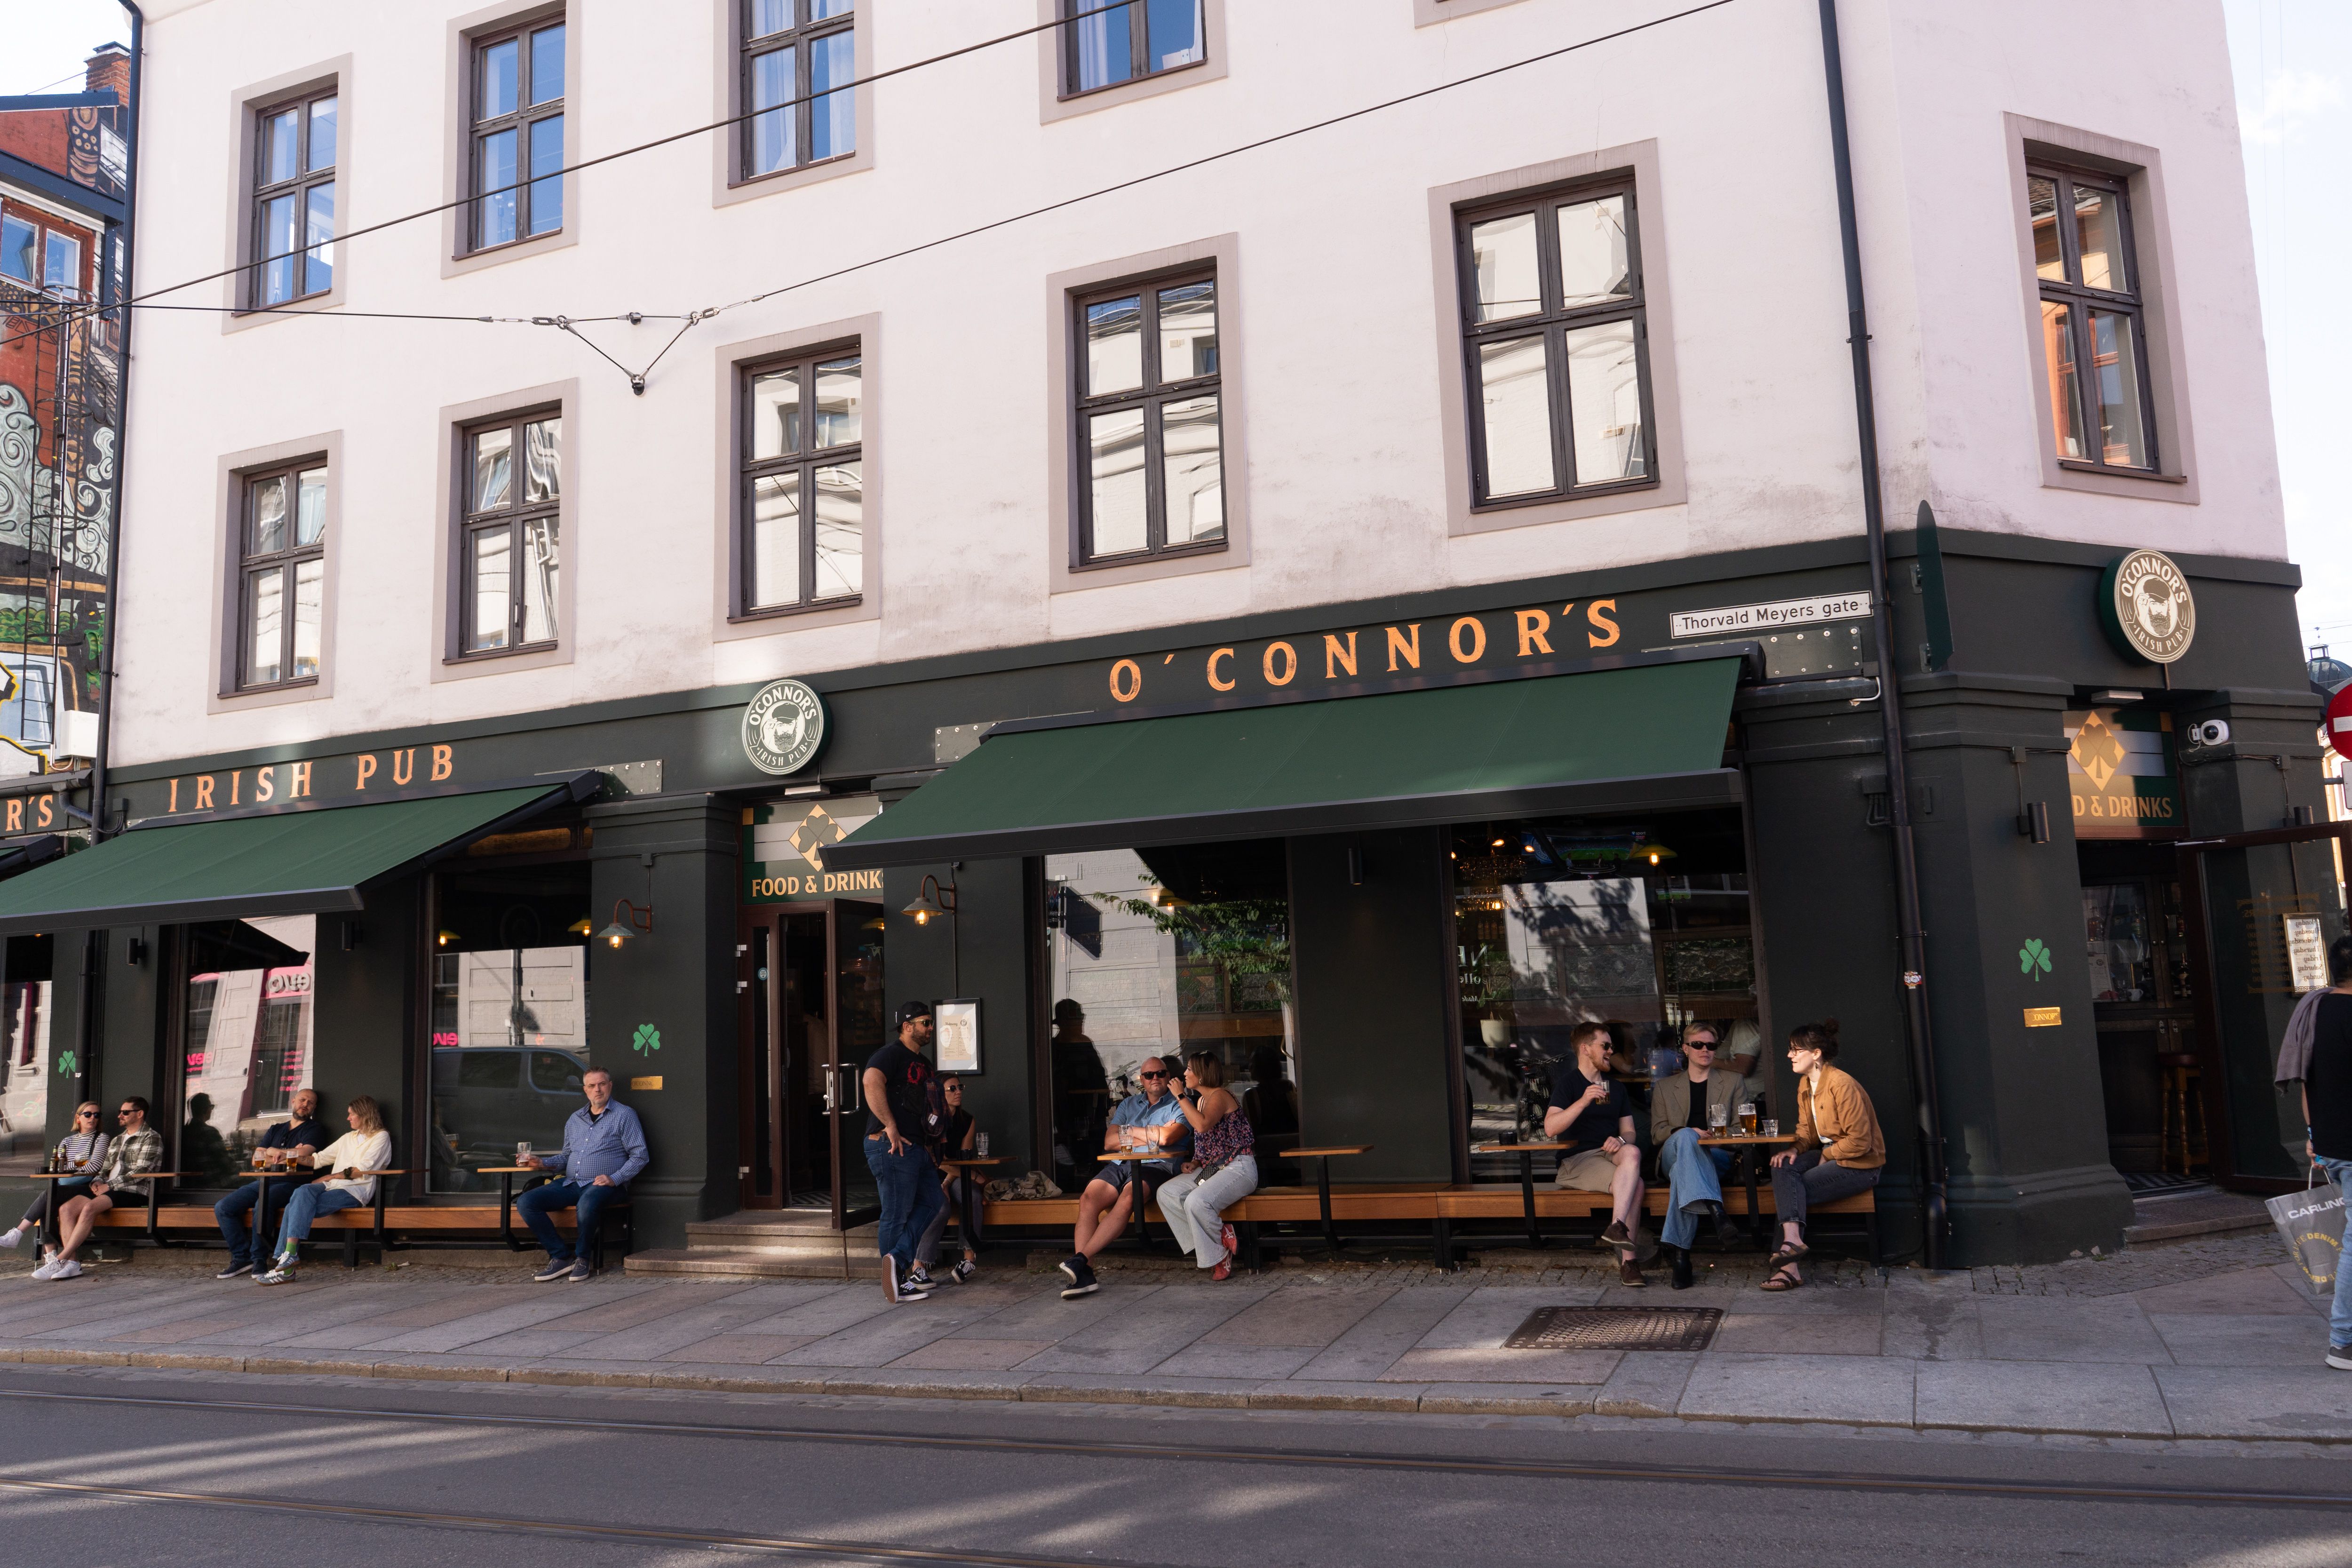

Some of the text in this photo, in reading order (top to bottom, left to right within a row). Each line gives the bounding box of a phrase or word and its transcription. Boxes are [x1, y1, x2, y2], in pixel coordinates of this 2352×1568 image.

[1682, 598, 1859, 630] Thorvald Meyers gate
[2134, 627, 2183, 652] IRISH PUB
[757, 744, 808, 766] IRISH PUB
[168, 745, 453, 813] IRISH PUB
[2090, 796, 2104, 817] &
[2107, 796, 2173, 818] DRINKS
[752, 869, 884, 897] FOOD & DRINK
[2306, 1232, 2338, 1247] DENIM
